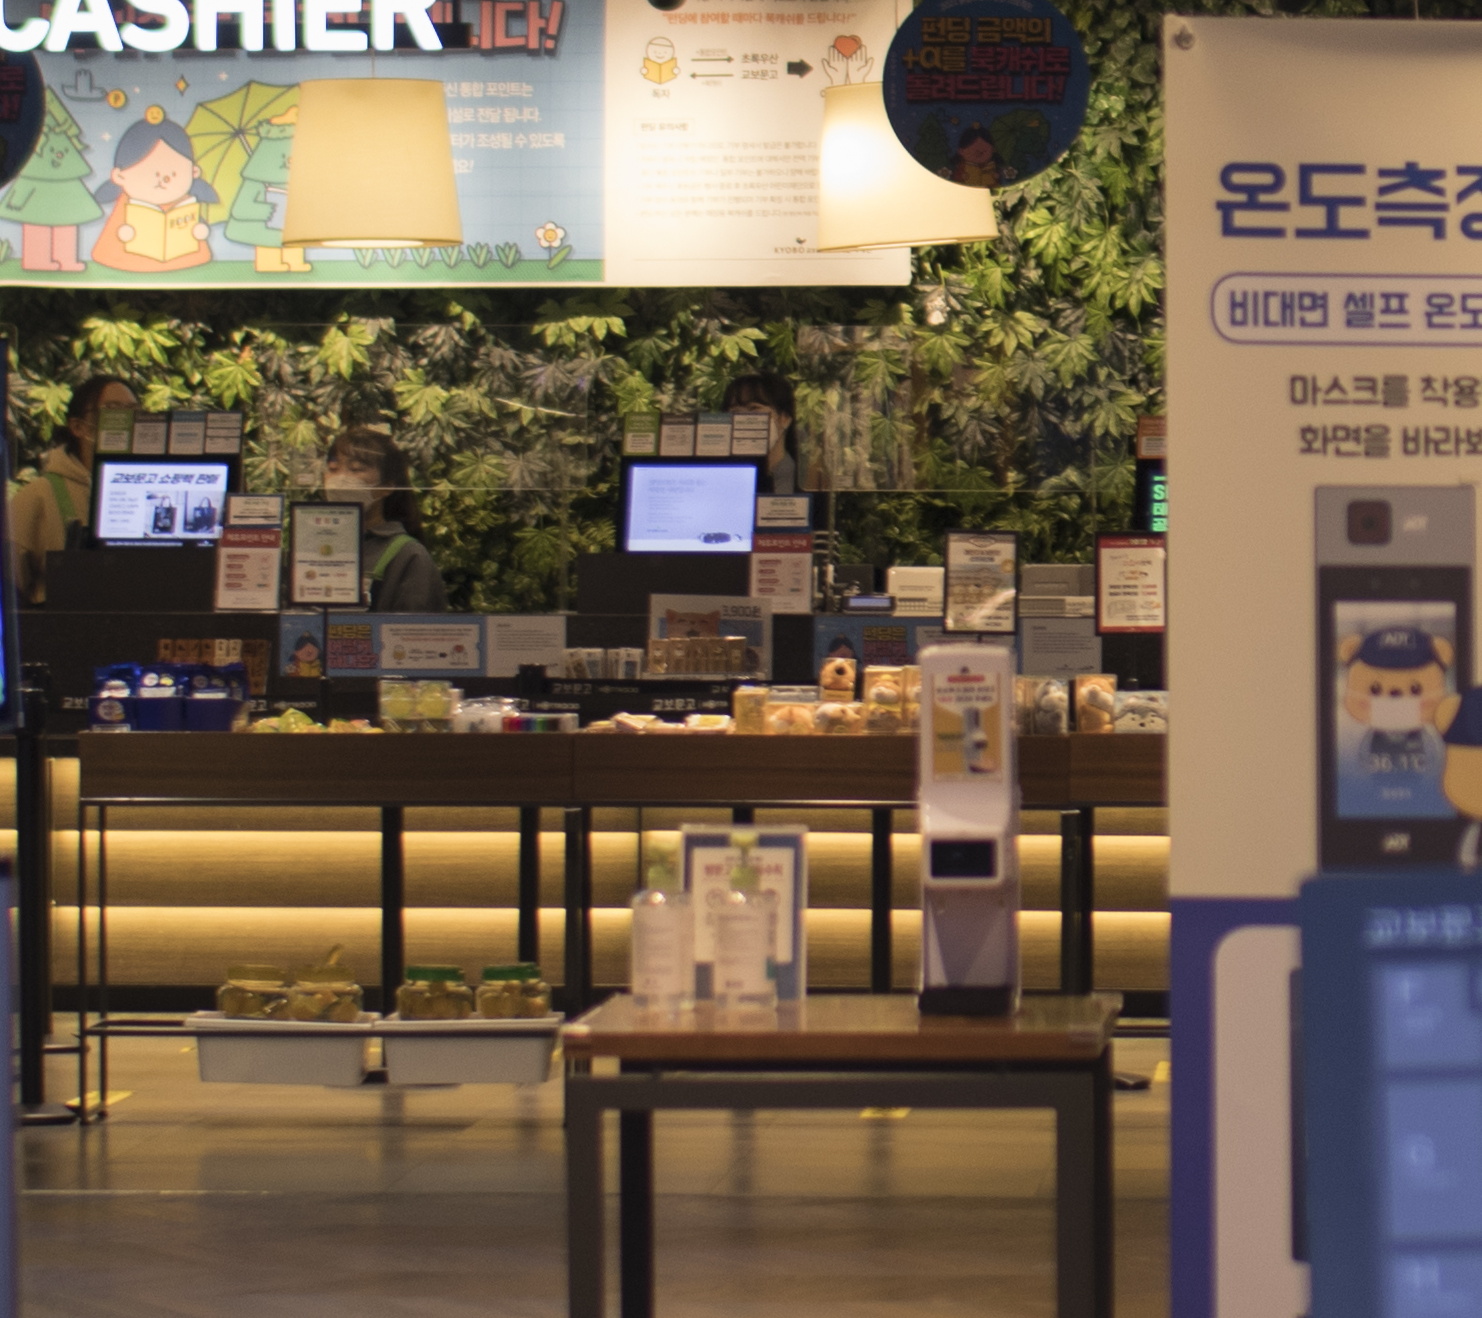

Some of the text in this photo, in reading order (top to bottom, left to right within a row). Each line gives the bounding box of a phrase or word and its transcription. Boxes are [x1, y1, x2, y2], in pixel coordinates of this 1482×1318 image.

[921, 17, 1052, 44] 펀딩 금액의
[971, 46, 1071, 72] 북캐쉬로
[486, 81, 533, 98] 포인트는
[529, 133, 565, 150] 있도록
[1228, 289, 1331, 333] 비대면
[1343, 289, 1412, 333] 셀프
[1289, 373, 1410, 411] 마스크를
[1298, 423, 1391, 461] 화면을
[110, 472, 158, 485] 교보문고
[652, 698, 696, 711] 교보문고
